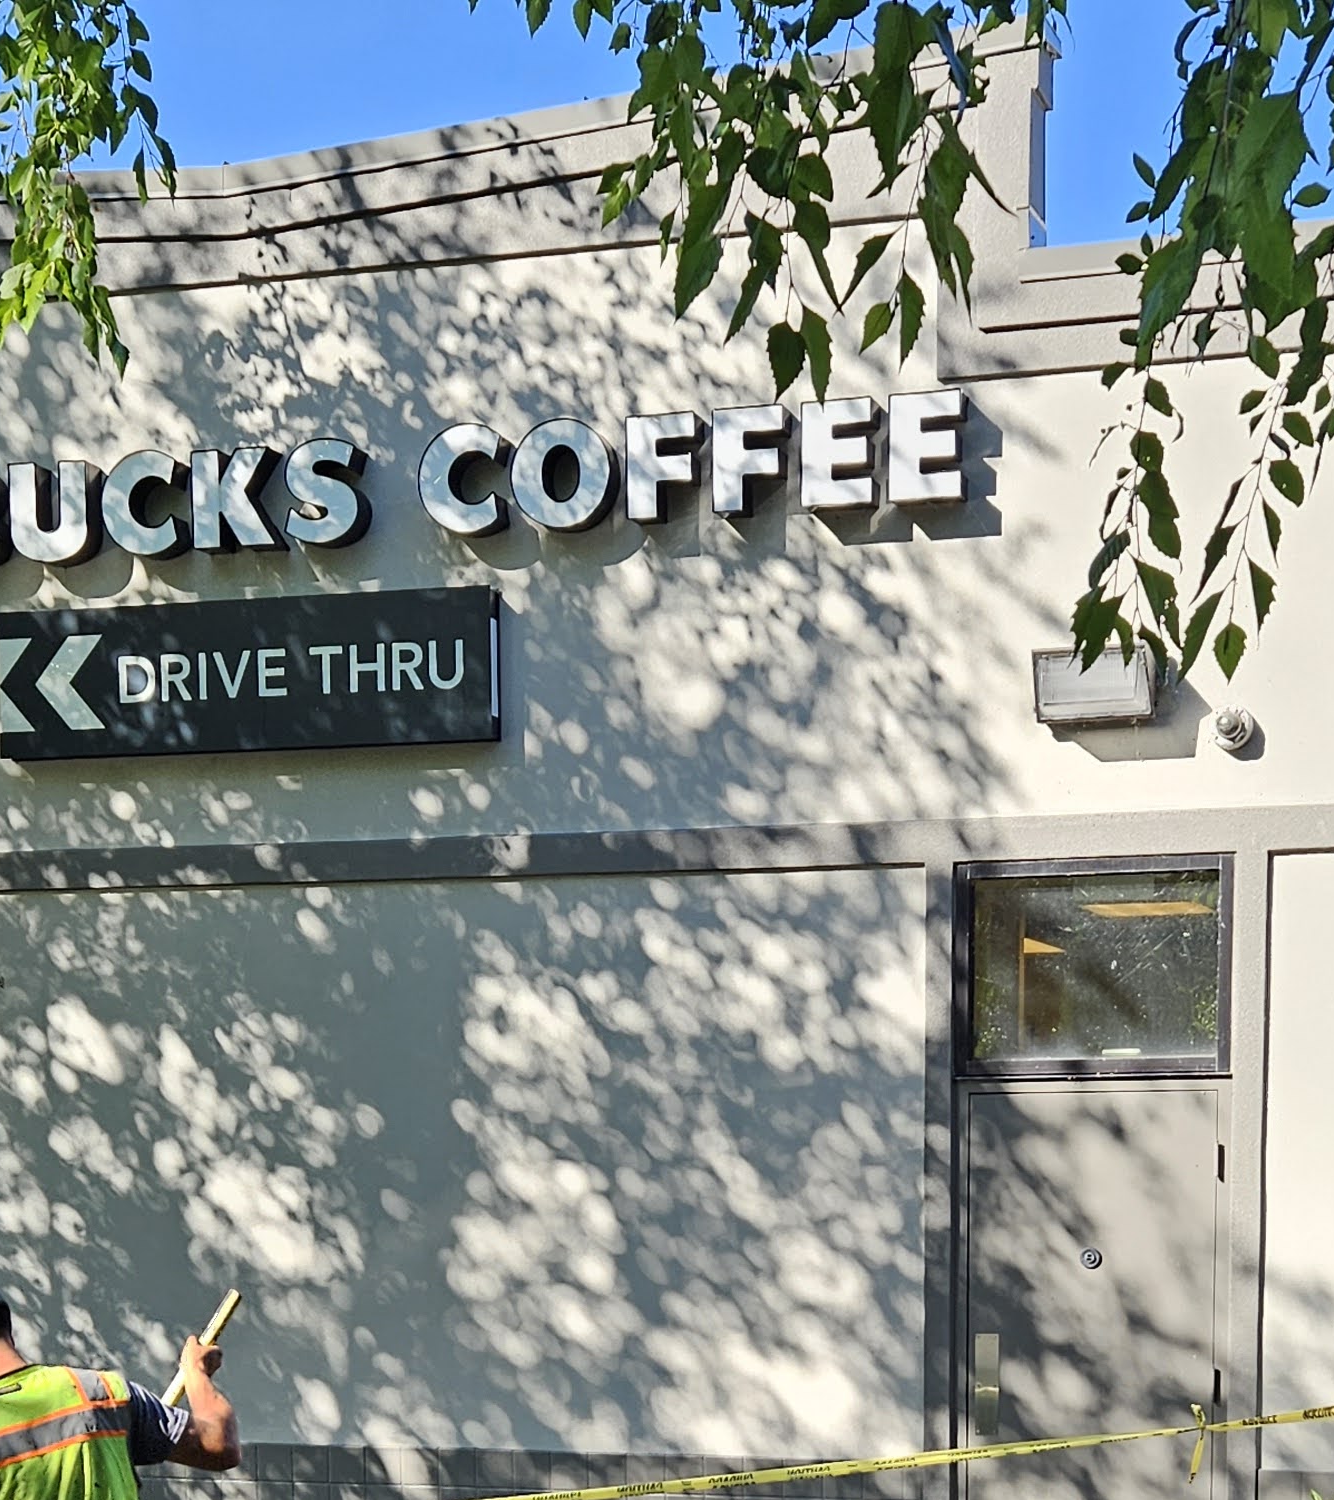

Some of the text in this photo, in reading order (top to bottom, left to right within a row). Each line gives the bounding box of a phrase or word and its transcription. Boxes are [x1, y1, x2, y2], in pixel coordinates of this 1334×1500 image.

[417, 388, 965, 535] COFFEE
[117, 638, 465, 704] DRIVE THRU
